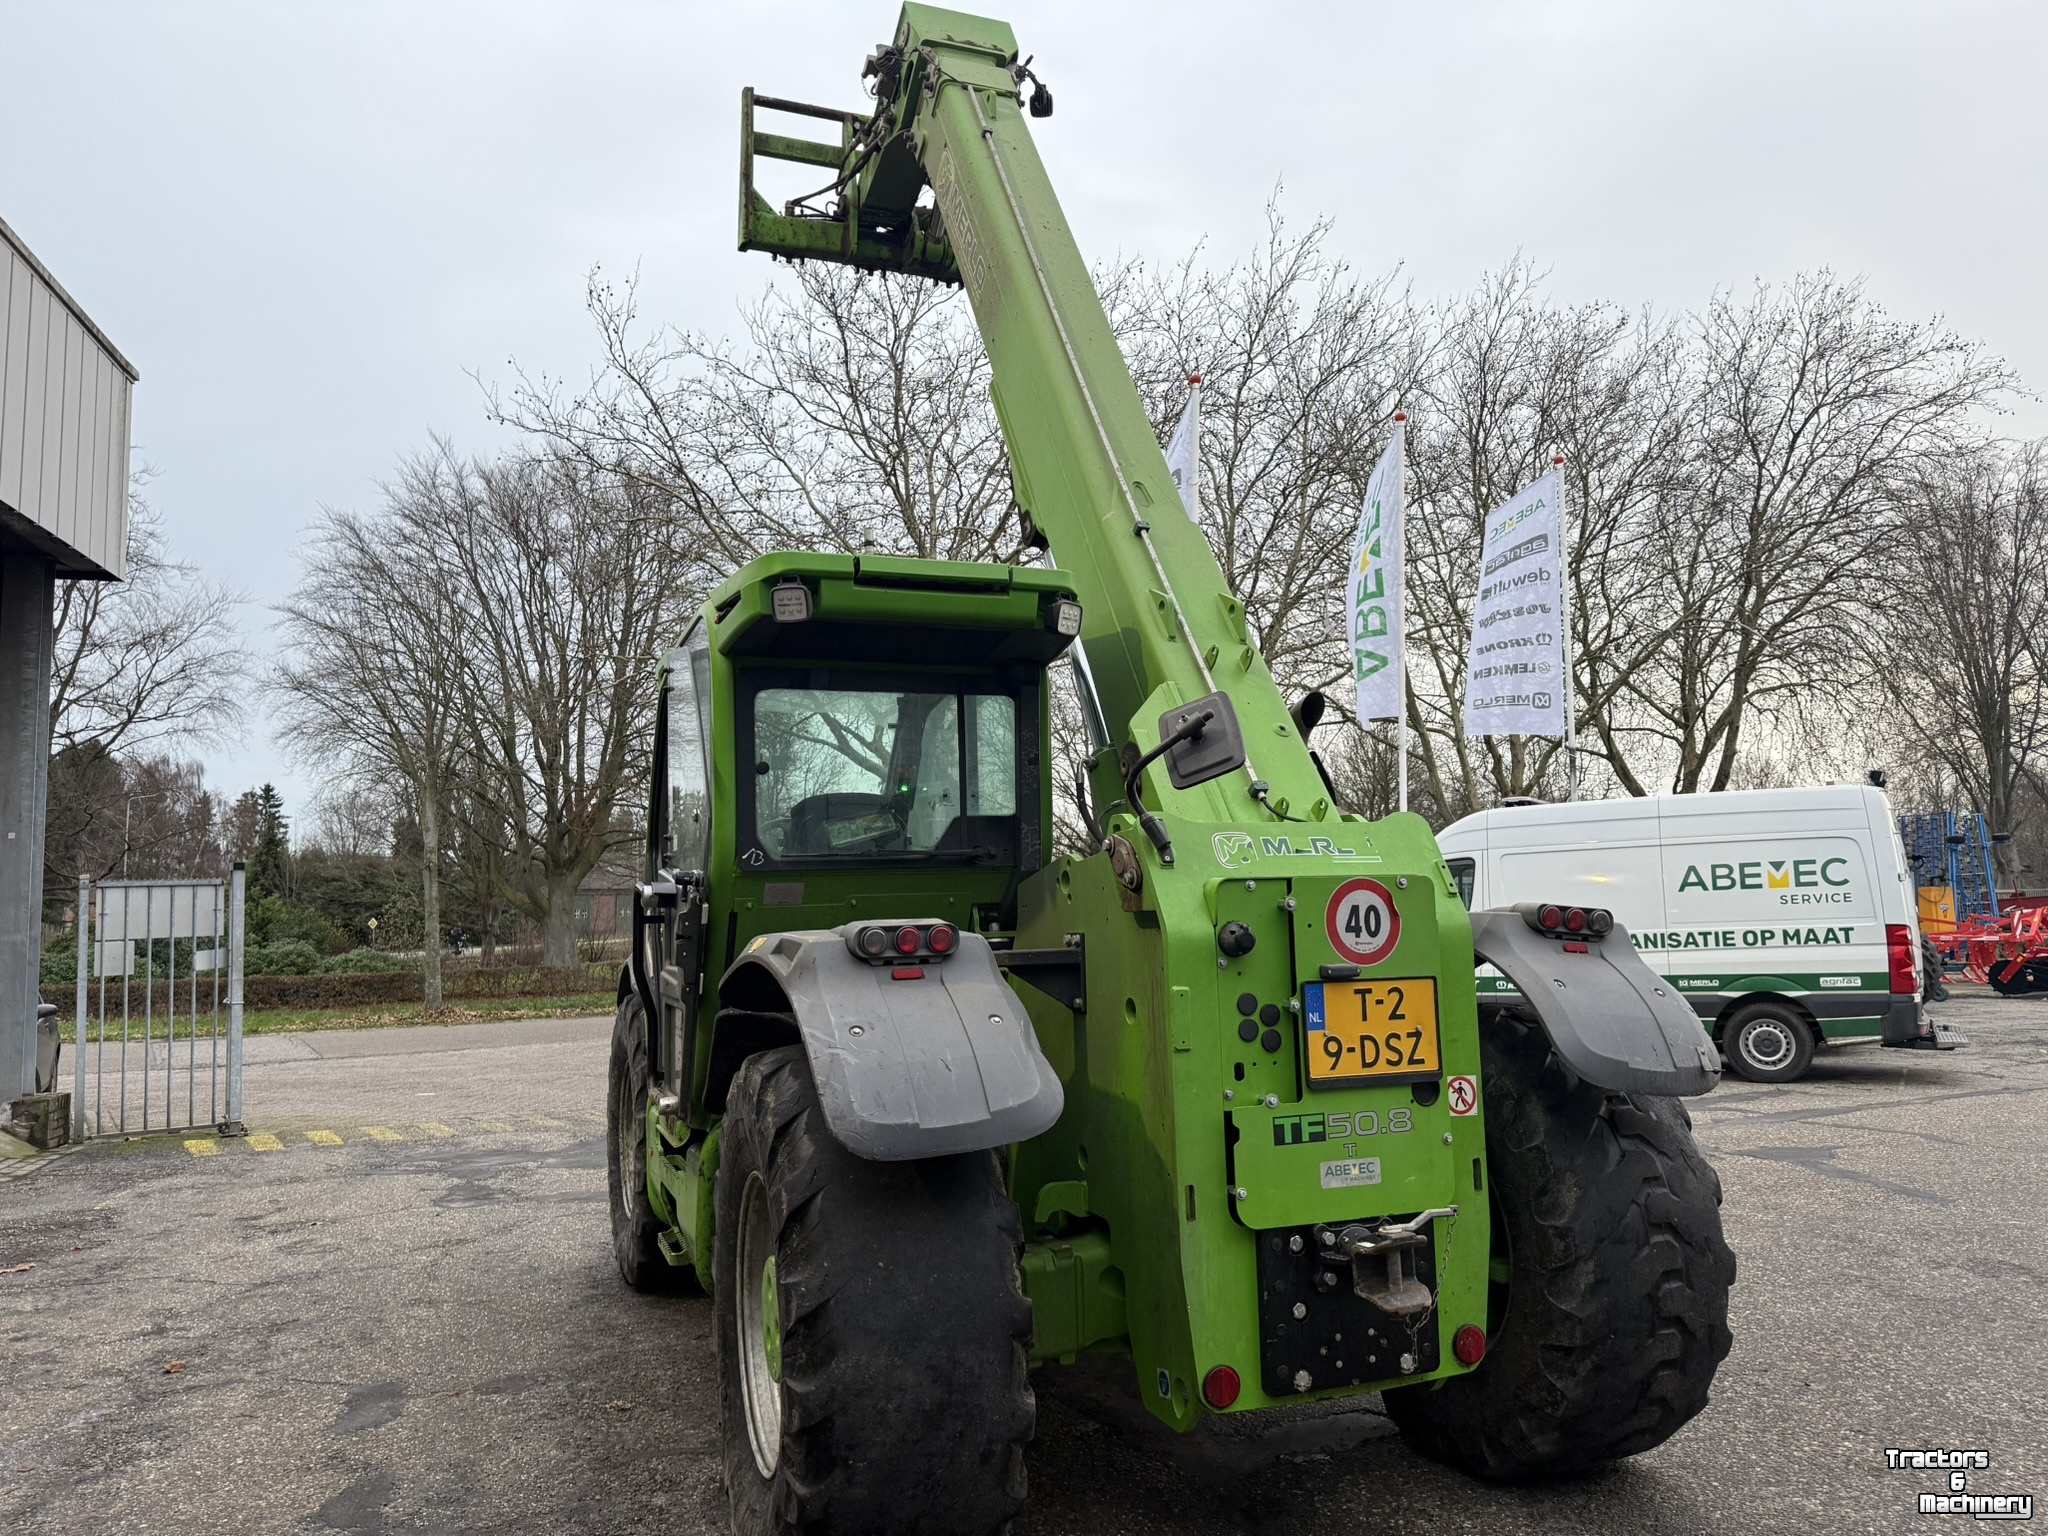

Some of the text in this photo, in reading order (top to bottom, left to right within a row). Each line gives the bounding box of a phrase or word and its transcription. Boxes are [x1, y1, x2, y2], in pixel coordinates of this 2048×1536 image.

[950, 183, 986, 294] MERLO
[1678, 857, 1850, 893] ABEMEC
[1779, 892, 1853, 905] SERVICE
[1345, 904, 1381, 938] 40
[1742, 929, 1776, 947] OP
[1782, 927, 1855, 945] MAAT
[1689, 979, 1720, 987] MERLO
[1309, 1012, 1323, 1023] NL
[1353, 986, 1406, 1022] T-2
[1323, 1031, 1426, 1071] 9-DSZ
[1343, 1142, 1357, 1157] T
